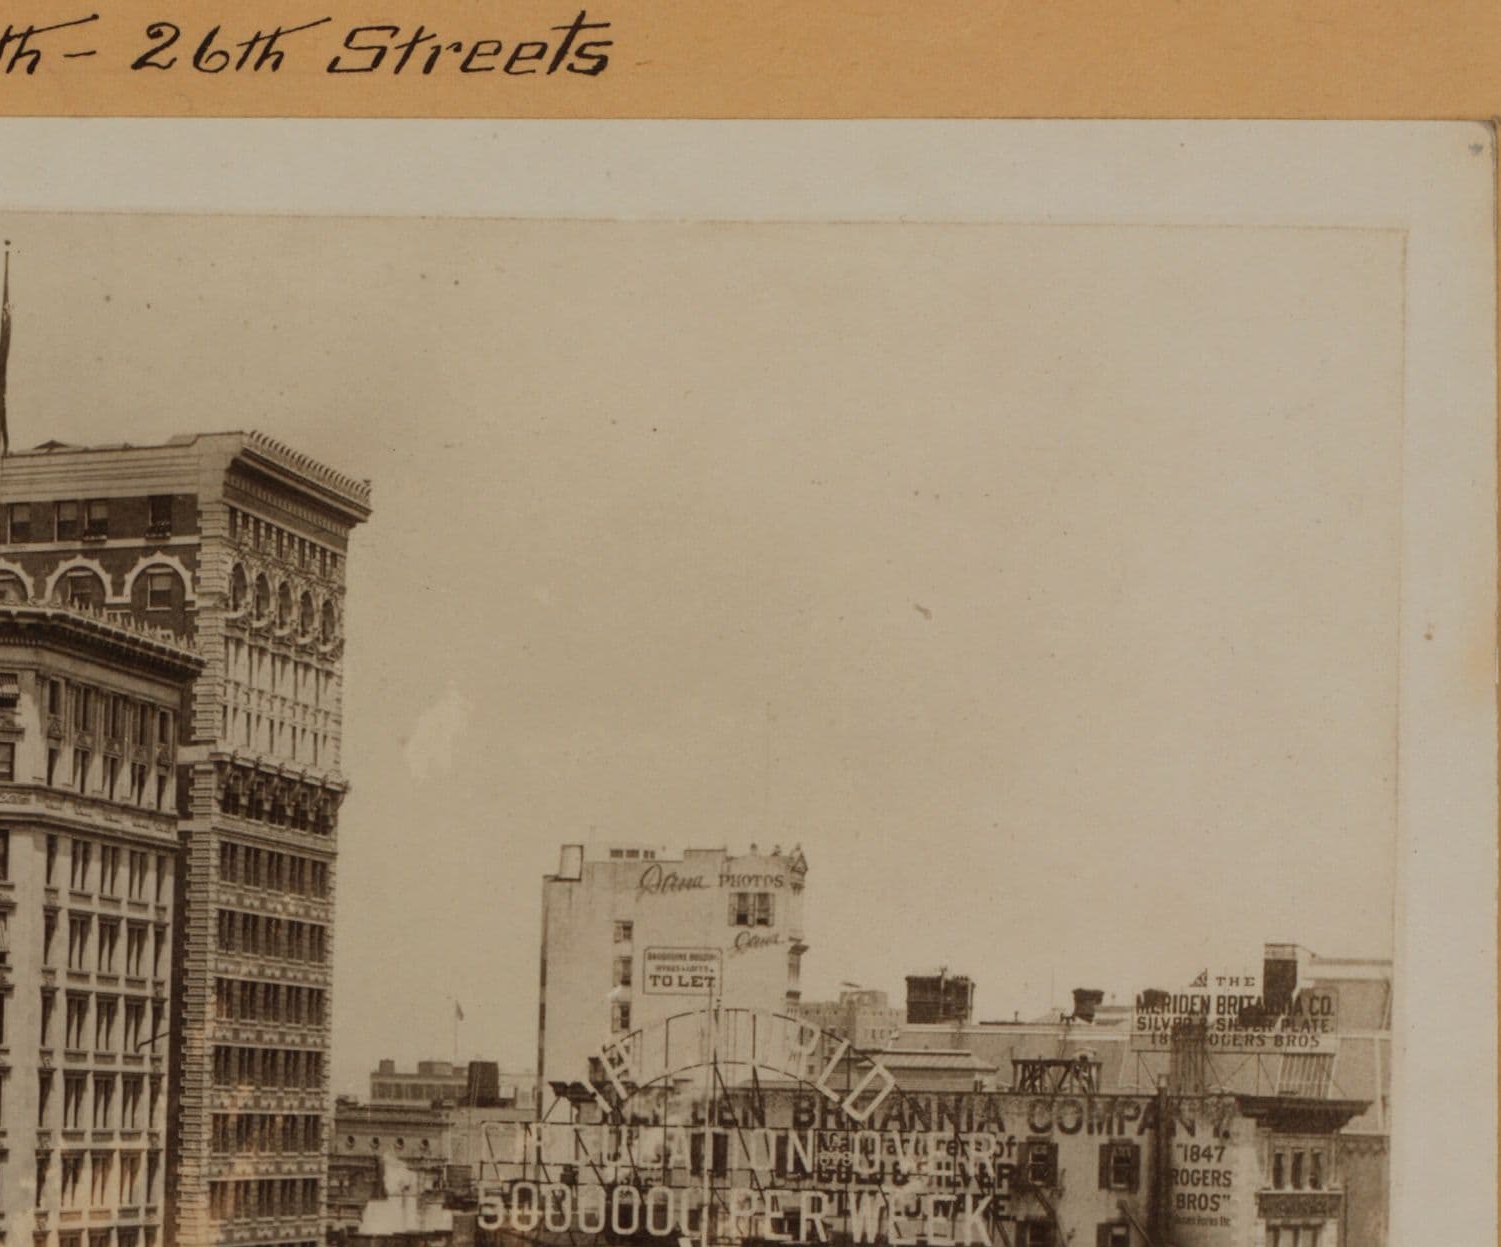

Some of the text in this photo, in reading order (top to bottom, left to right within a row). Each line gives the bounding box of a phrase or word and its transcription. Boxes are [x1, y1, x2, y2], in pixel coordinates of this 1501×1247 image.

[129, 17, 331, 75] 26th
[326, 9, 615, 77] Streets
[649, 975, 715, 988] TO LET
[1215, 976, 1256, 987] THE
[1310, 996, 1335, 1017] CO.
[1274, 1035, 1320, 1048] BROS
[1171, 1168, 1233, 1188] ROGERS
[729, 1190, 828, 1243] PER
[851, 1193, 994, 1247] WEEK
